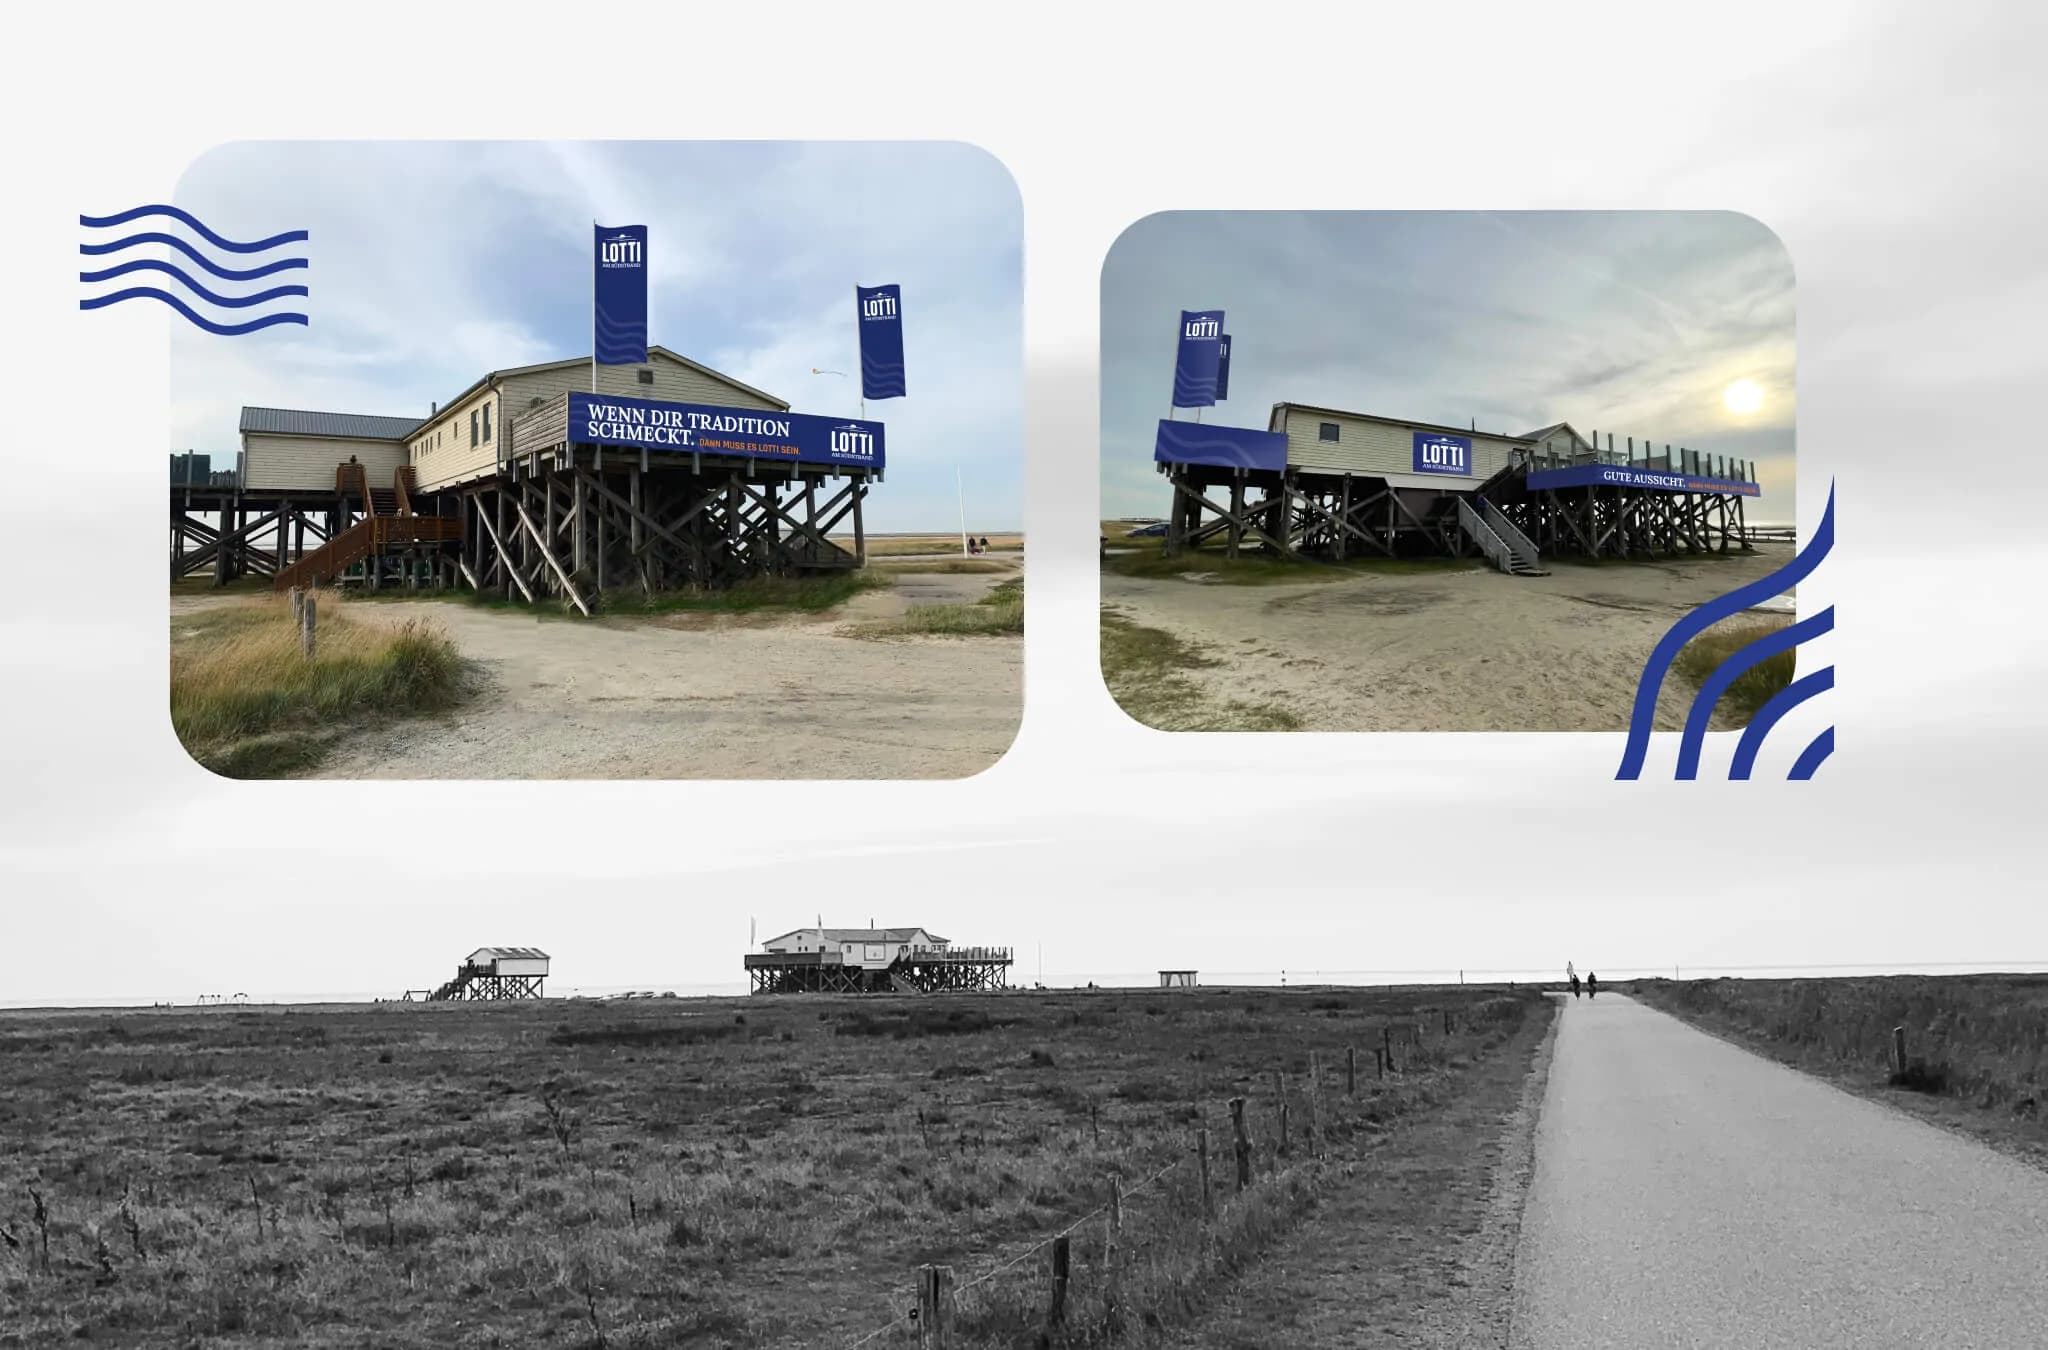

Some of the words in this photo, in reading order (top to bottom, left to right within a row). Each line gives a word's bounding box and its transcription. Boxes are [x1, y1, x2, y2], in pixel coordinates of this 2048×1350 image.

[602, 241, 641, 263] LOTTI
[863, 297, 896, 317] LOTTI
[1185, 321, 1218, 337] LOTTI
[587, 403, 646, 425] WENN
[650, 409, 684, 428] DIR
[687, 412, 791, 438] TRADITION
[588, 420, 695, 446] SCHMECKT.
[699, 438, 721, 449] DANN
[722, 440, 745, 451] MUSS
[747, 442, 757, 452] ES
[758, 444, 779, 454] LOTTI
[831, 430, 873, 456] LOTTI
[1422, 443, 1464, 467] LOTTI
[1603, 470, 1632, 483] GUTE
[1633, 473, 1686, 489] AUSSICHT.
